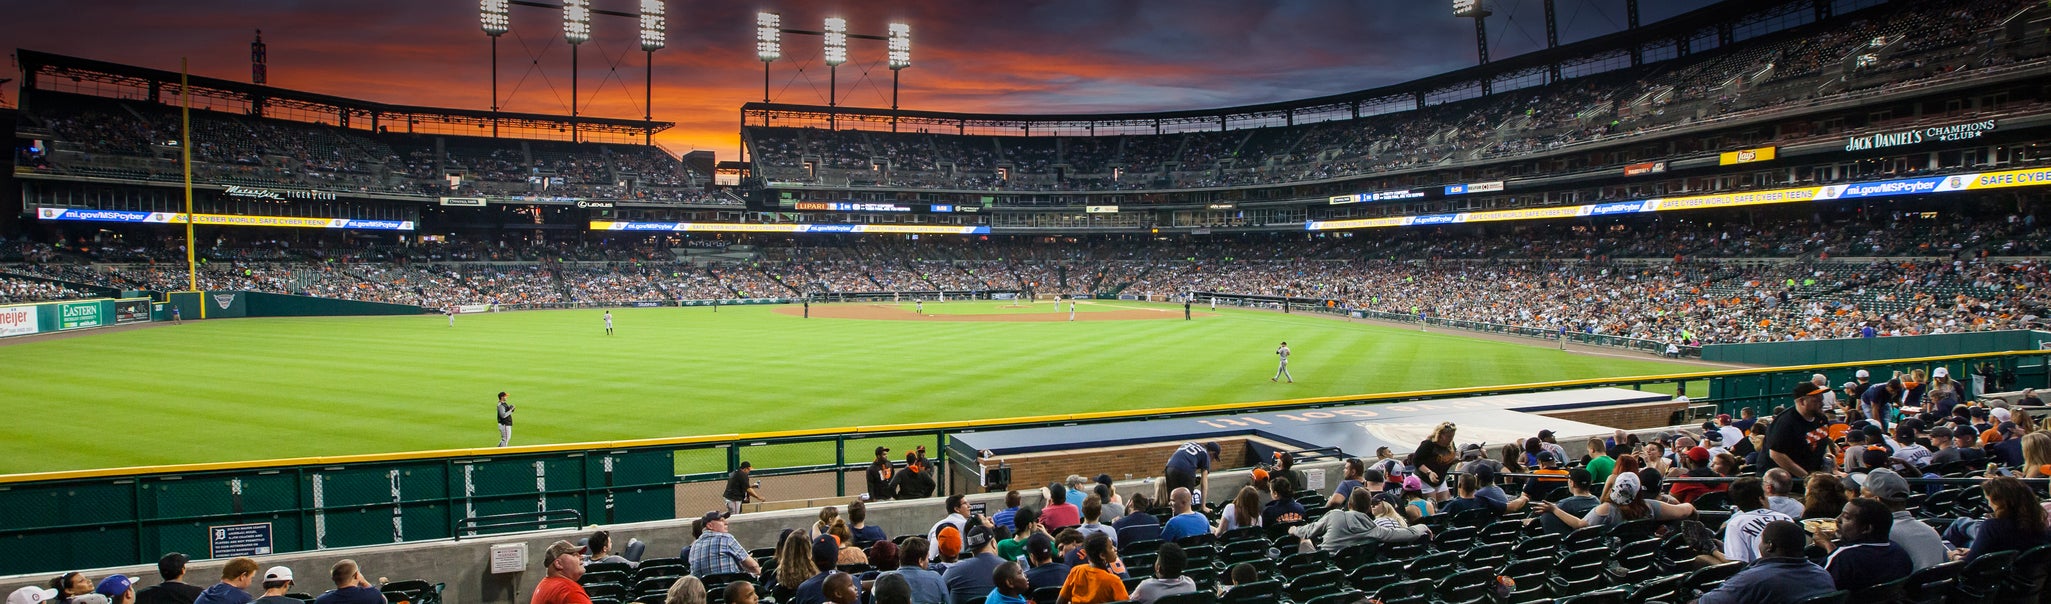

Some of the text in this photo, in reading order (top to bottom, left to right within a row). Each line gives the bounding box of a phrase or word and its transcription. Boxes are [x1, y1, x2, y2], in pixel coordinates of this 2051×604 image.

[1926, 119, 1995, 137] CHAMPIONS
[1846, 129, 1922, 151] JACK DANIEL'S
[1948, 132, 1974, 142] CLUB
[1980, 174, 2013, 185] SAFE
[1847, 181, 1935, 196] mi.gov/MSPcyber
[287, 190, 336, 200] TIGER CLUB
[1663, 200, 1679, 208] SAFE
[1755, 193, 1782, 201] CYBER
[1786, 190, 1813, 199] TEENS
[66, 211, 144, 220] mi.gov/MSPcyber
[176, 214, 198, 222] SAE
[259, 217, 278, 225] SAFE
[63, 304, 97, 317] EASTERN
